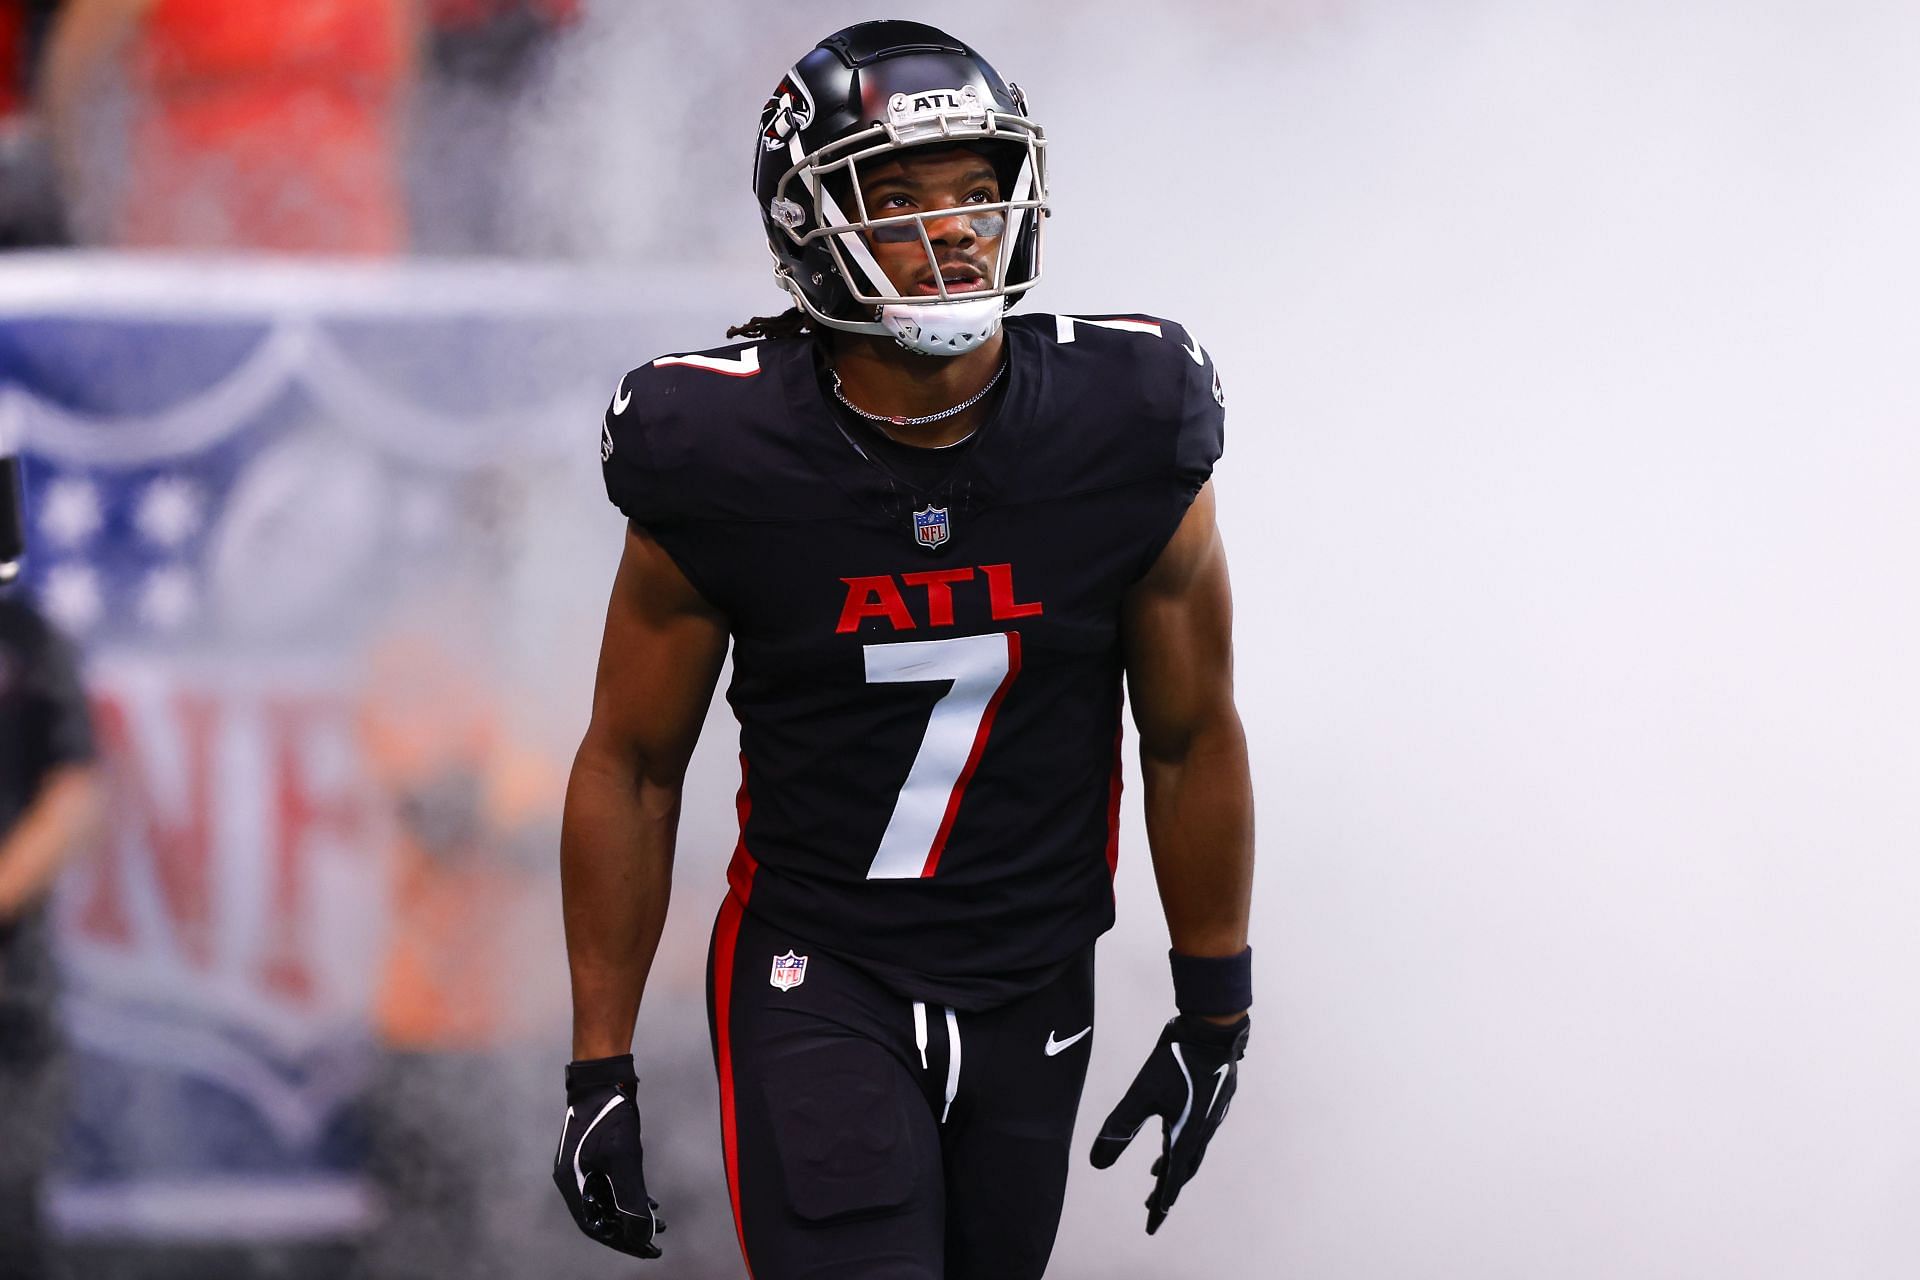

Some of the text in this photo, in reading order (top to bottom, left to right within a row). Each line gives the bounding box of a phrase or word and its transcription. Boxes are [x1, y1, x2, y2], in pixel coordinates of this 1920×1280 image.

[914, 94, 959, 112] ATL
[920, 525, 945, 541] NFL
[836, 563, 1043, 634] ATL
[863, 631, 1022, 880] 7
[776, 969, 799, 984] NFL
